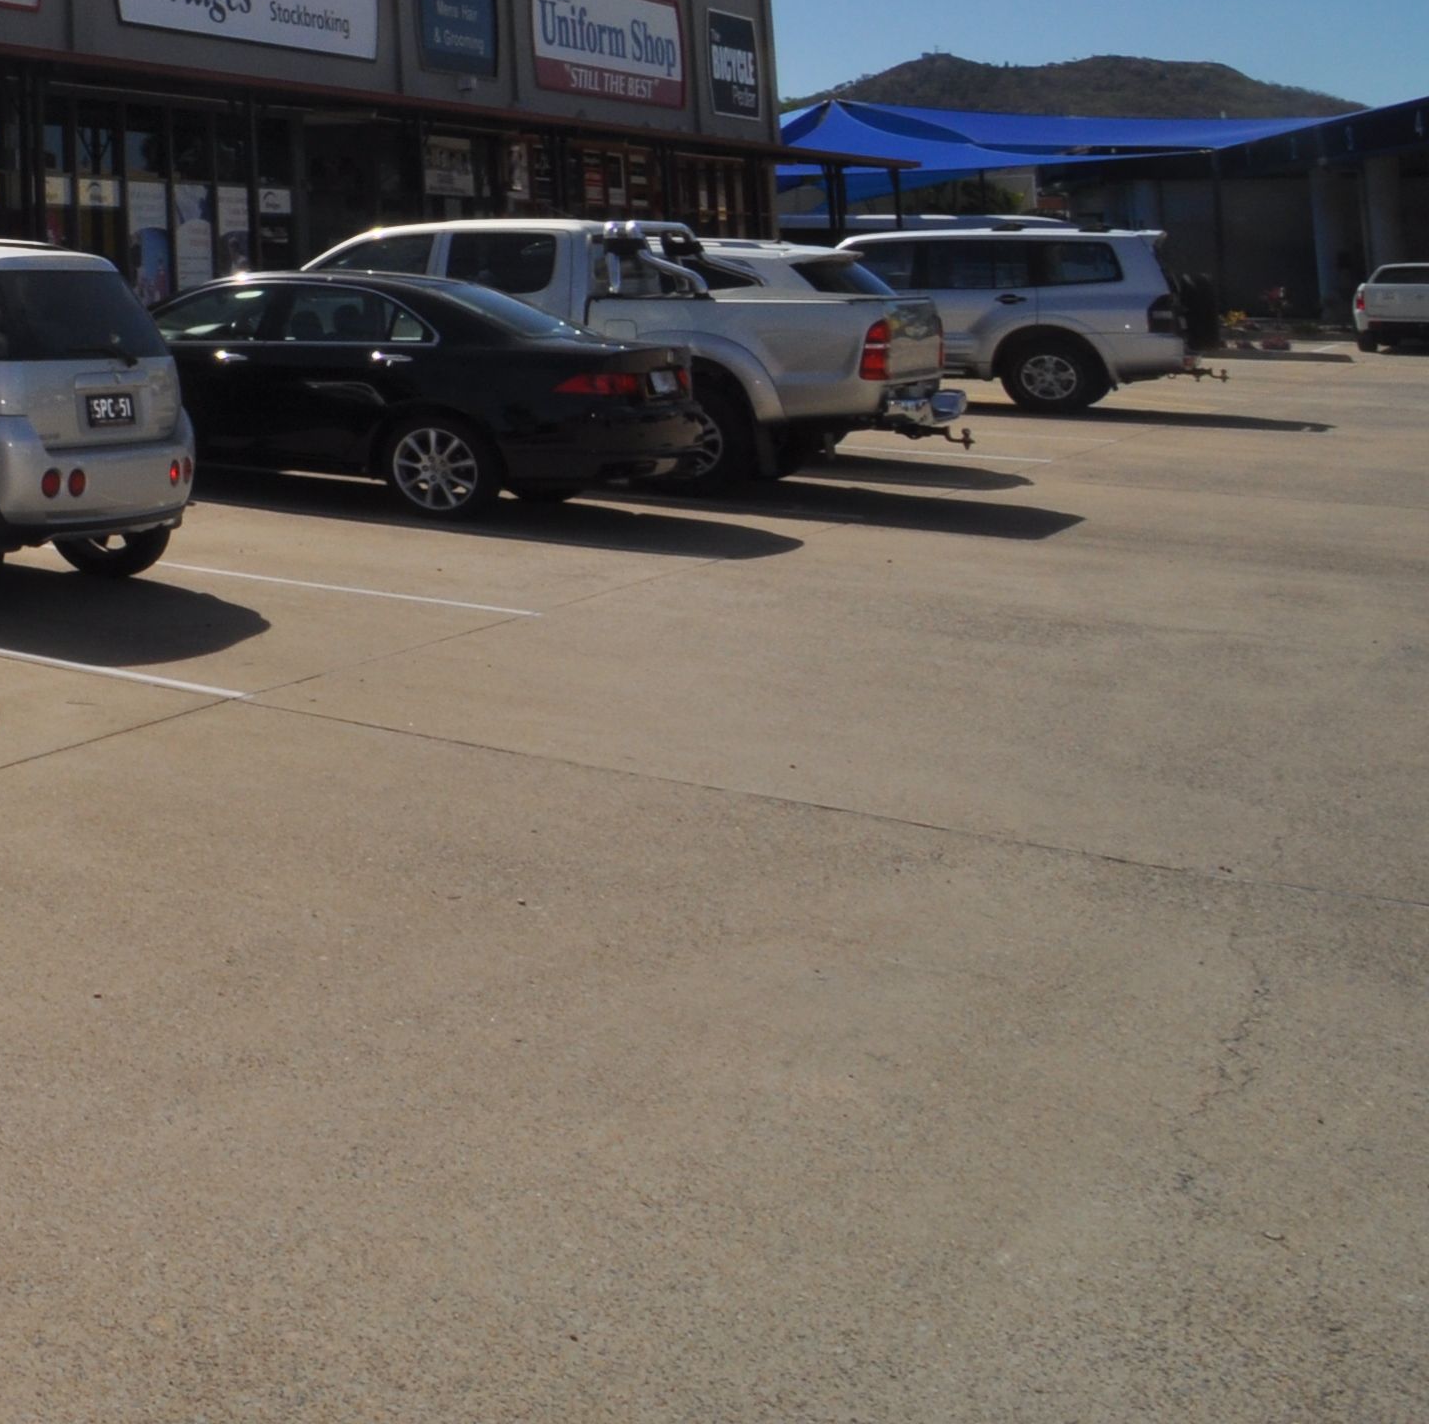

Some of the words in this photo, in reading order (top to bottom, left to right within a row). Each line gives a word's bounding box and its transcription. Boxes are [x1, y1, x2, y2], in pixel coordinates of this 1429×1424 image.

[269, 0, 350, 38] Stockbroking
[539, 0, 626, 58] Uniform
[630, 18, 677, 77] Shop
[602, 73, 625, 95] THE
